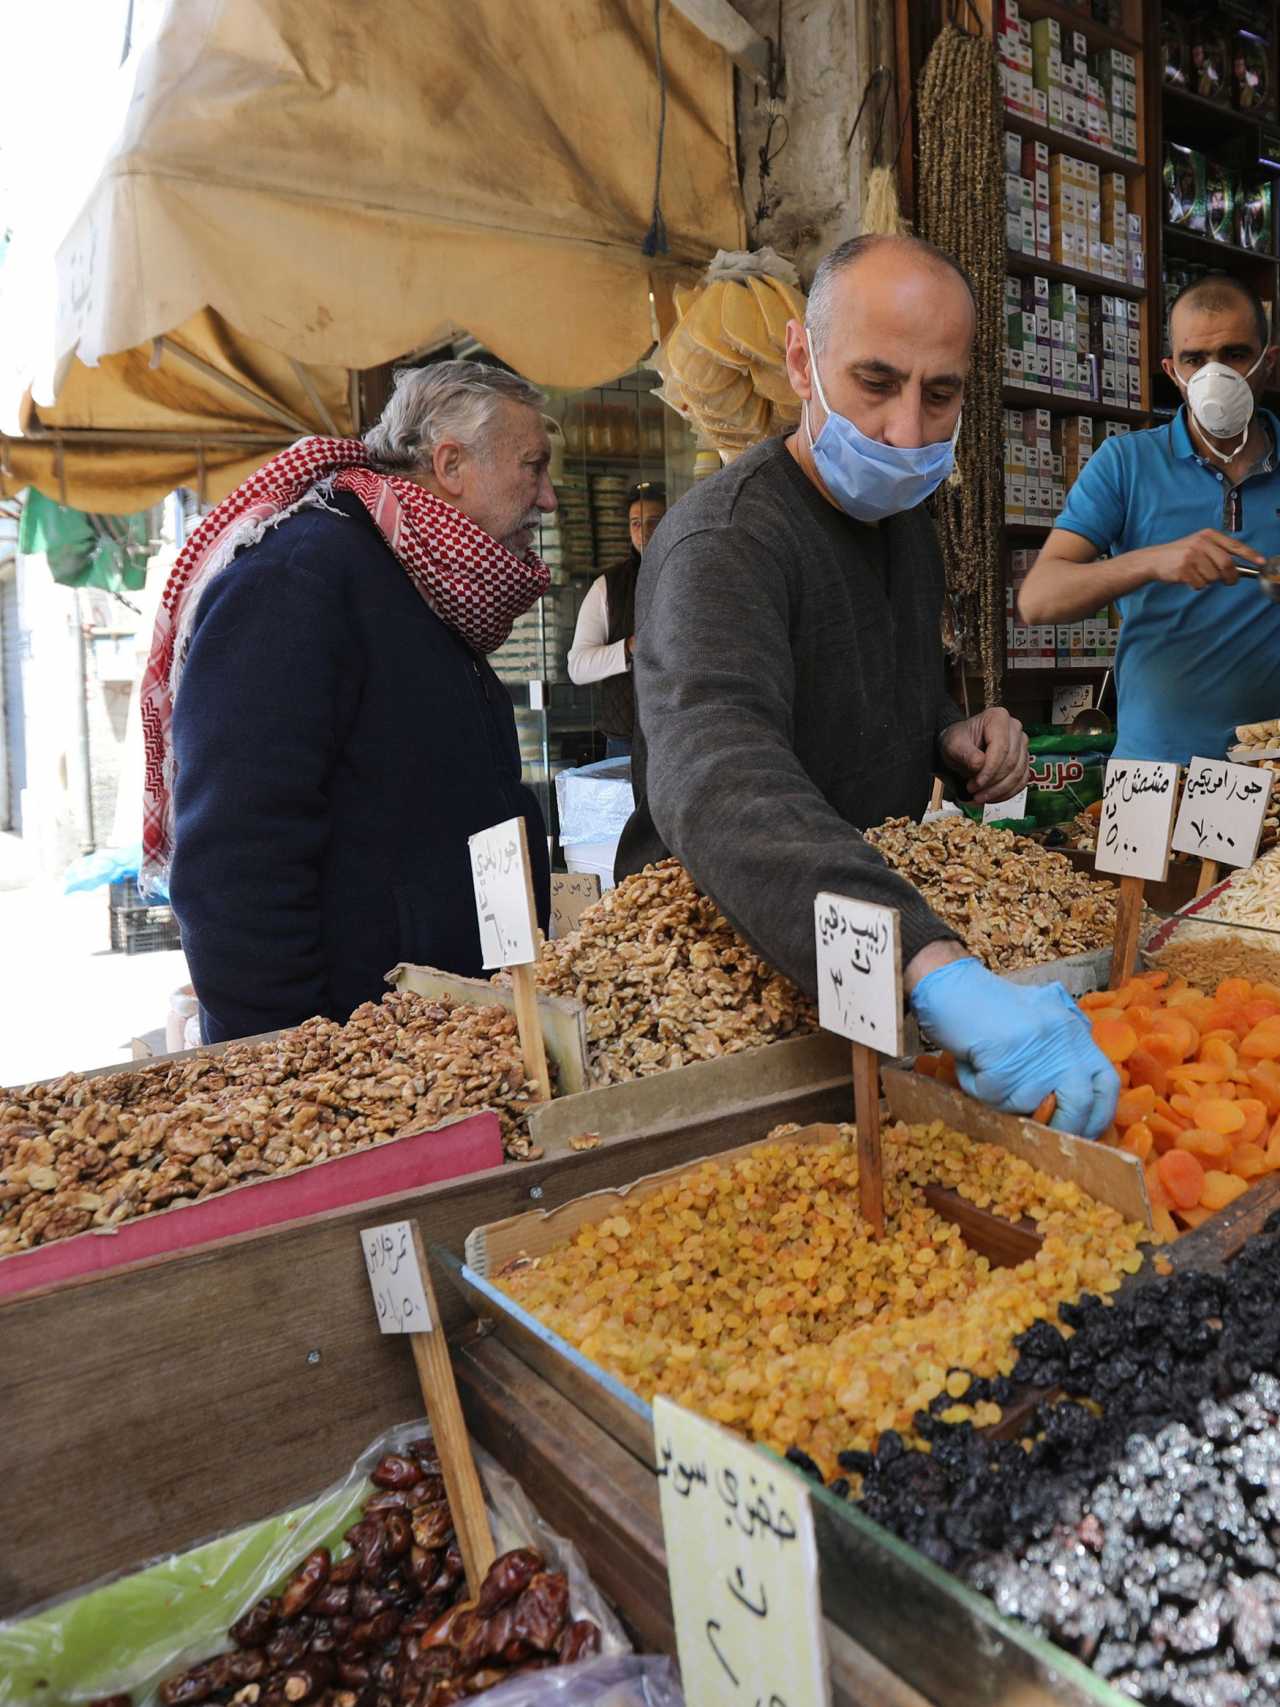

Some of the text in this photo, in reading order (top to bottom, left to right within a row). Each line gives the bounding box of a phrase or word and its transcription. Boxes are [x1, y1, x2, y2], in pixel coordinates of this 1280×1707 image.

[1122, 765, 1169, 802] مشمش
[1226, 775, 1262, 803] جوز
[850, 917, 888, 954] زبيب
